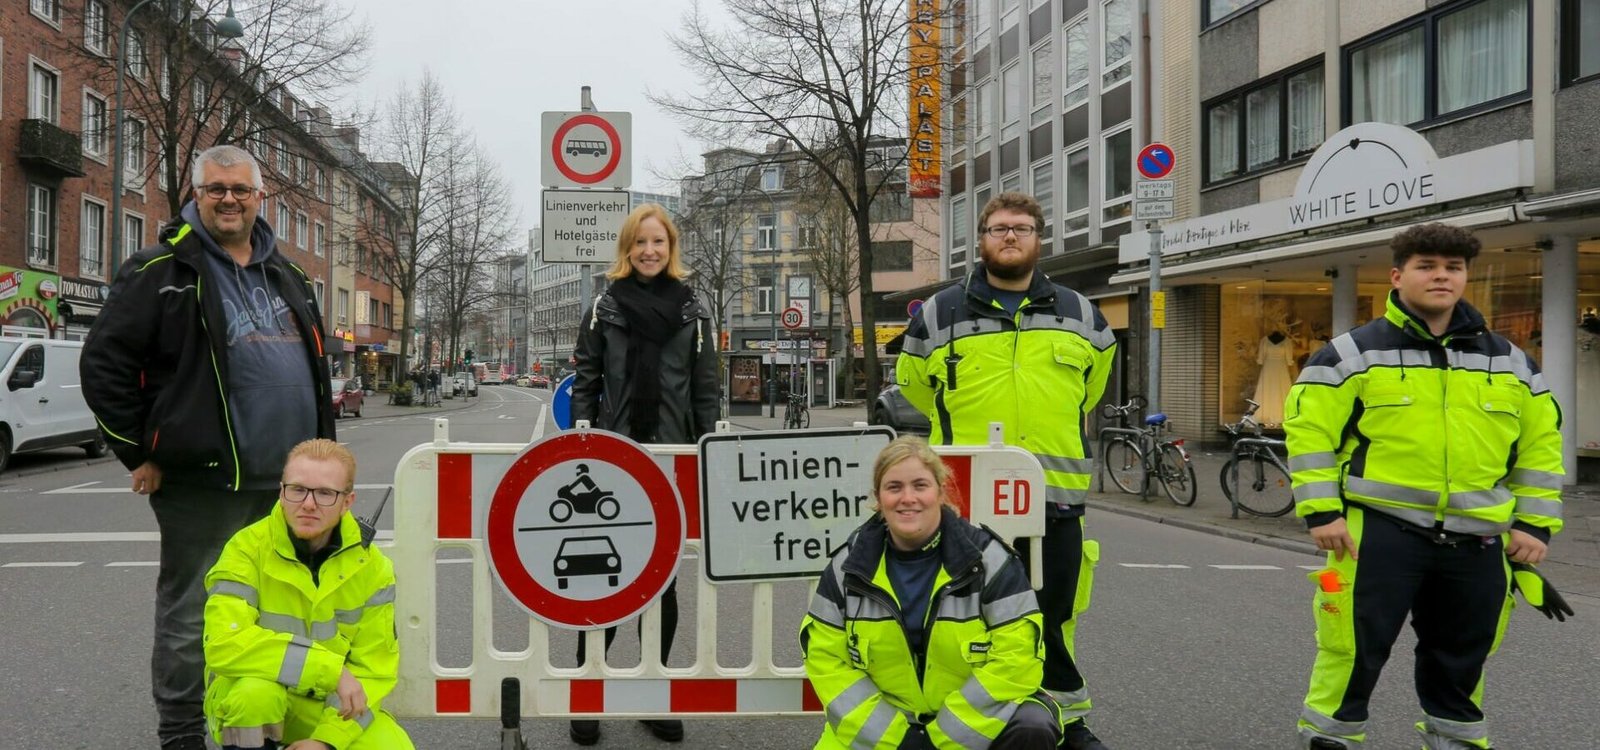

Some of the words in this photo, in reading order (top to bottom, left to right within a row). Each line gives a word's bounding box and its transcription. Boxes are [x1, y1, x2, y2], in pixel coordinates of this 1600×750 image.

[545, 199, 626, 213] Linienverkehr
[1289, 191, 1357, 225] WHITE
[1368, 173, 1434, 209] LOVE
[575, 215, 597, 226] und
[554, 229, 618, 244] Hotelgäste
[575, 245, 596, 257] frei
[786, 313, 799, 323] 30
[738, 450, 860, 482] Linien-
[731, 489, 868, 523] verkehr
[993, 479, 1031, 515] ED
[773, 529, 832, 561] frei
